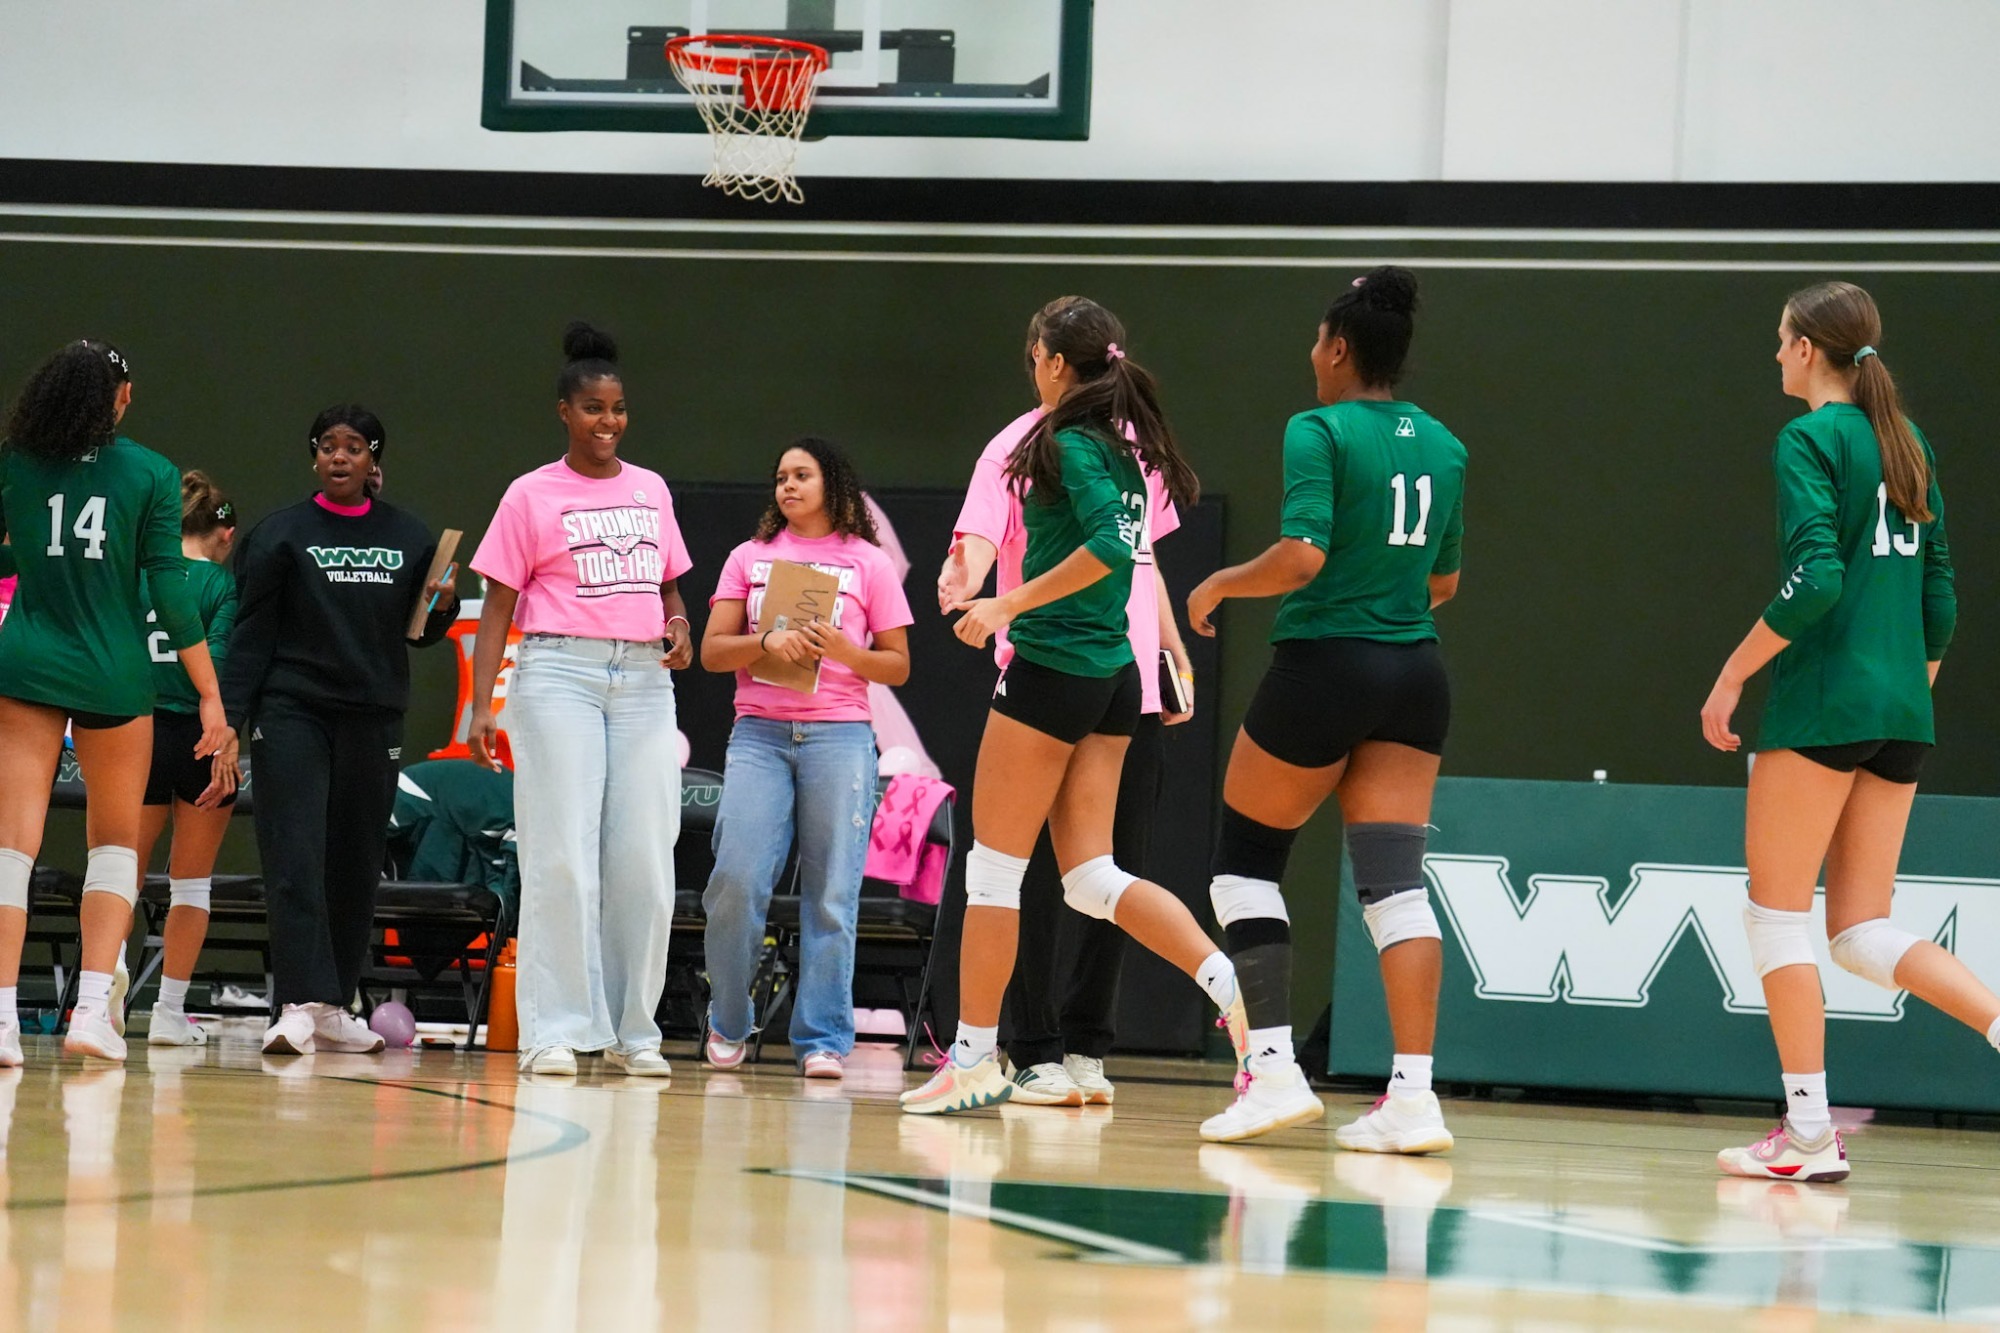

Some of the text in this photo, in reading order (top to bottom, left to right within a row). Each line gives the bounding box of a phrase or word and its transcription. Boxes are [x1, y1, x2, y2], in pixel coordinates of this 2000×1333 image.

[47, 493, 107, 560] 14
[562, 509, 660, 544] STRONGER
[1388, 473, 1431, 546] 11
[306, 546, 403, 570] WWU
[572, 549, 662, 585] TOGETHER
[326, 571, 394, 584] VOLLEYBALL
[681, 785, 723, 806] WU
[1422, 853, 2000, 1021] WW
